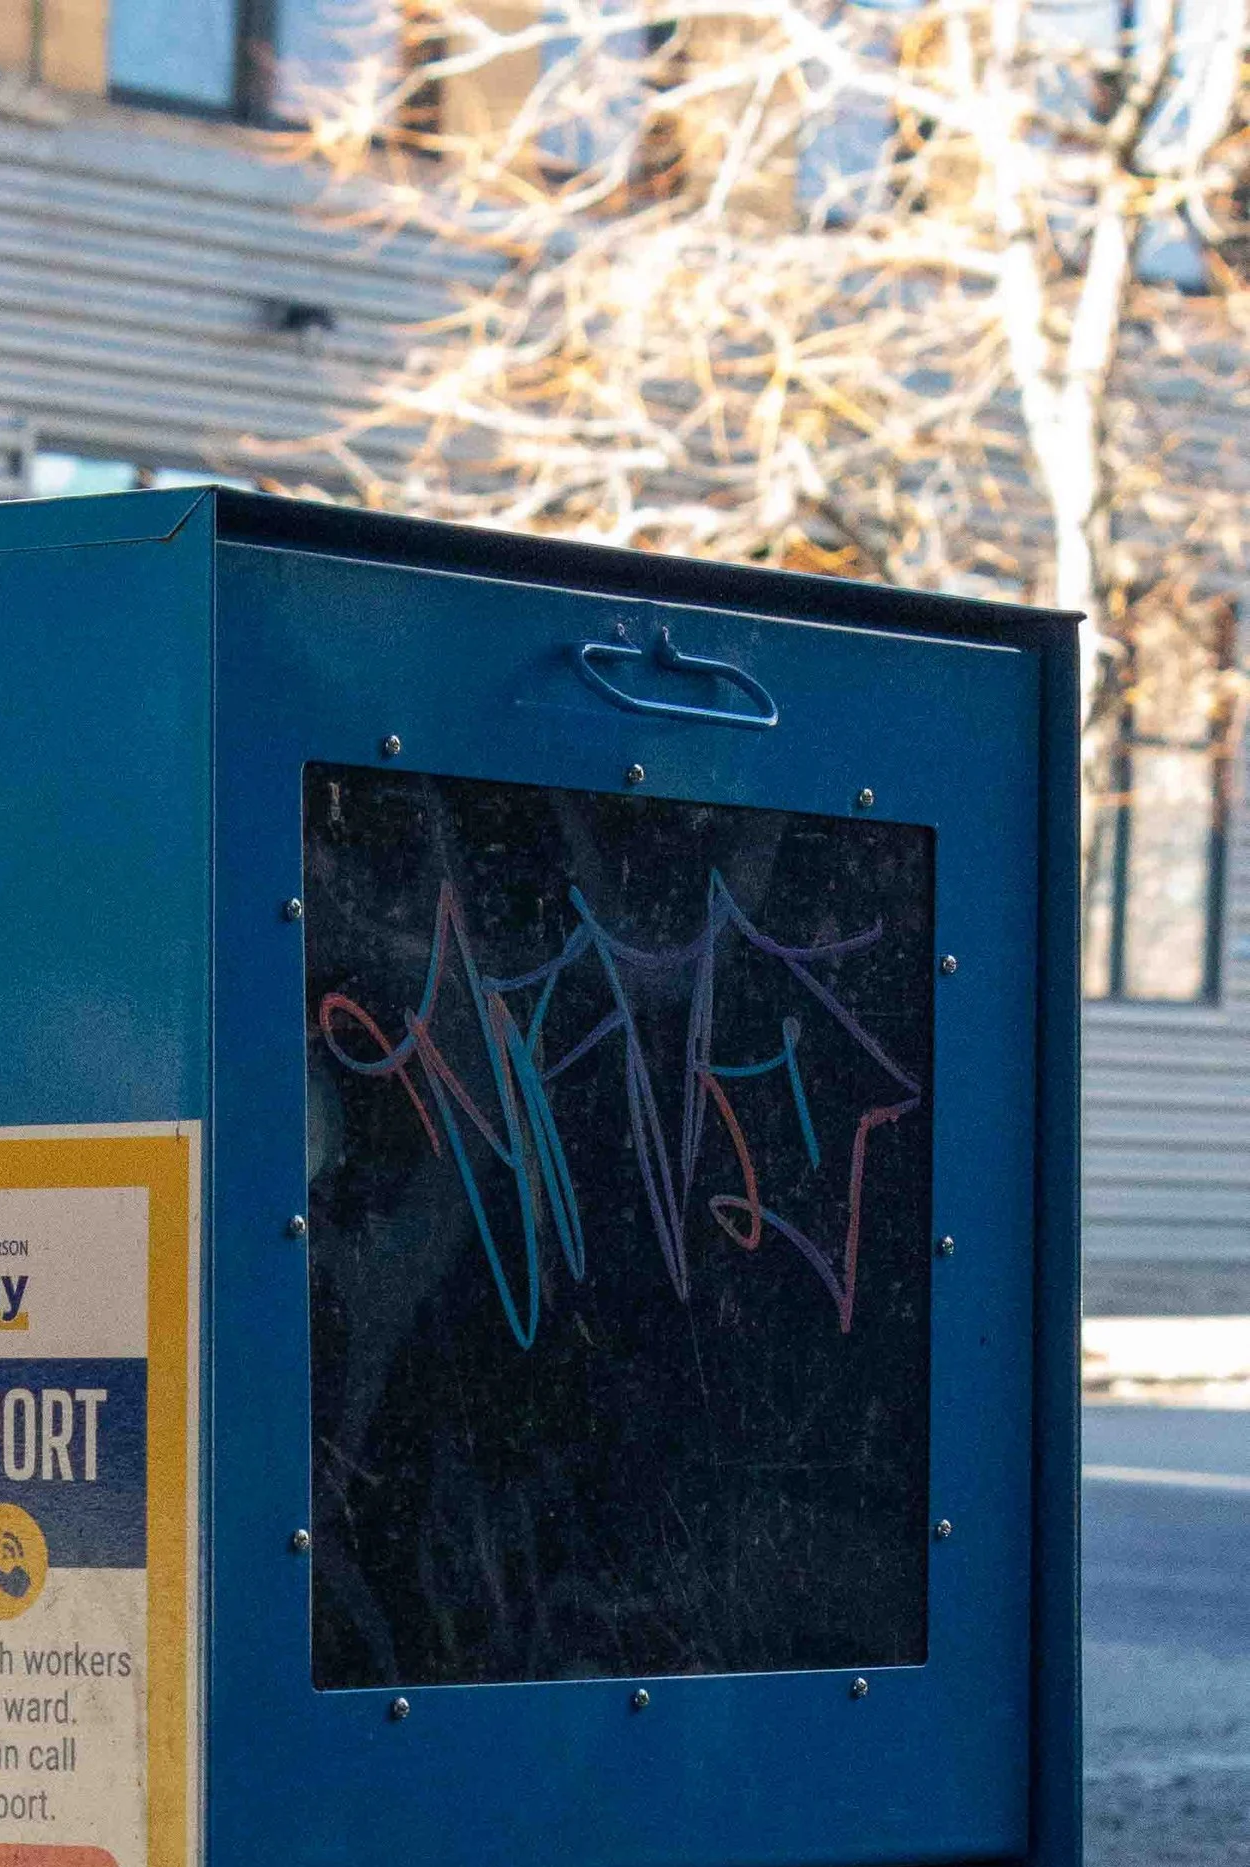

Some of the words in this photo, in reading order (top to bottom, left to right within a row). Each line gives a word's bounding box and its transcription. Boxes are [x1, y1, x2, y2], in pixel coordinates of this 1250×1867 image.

[24, 1643, 132, 1677] workers
[4, 1691, 77, 1725] ward.
[29, 1738, 76, 1772] call
